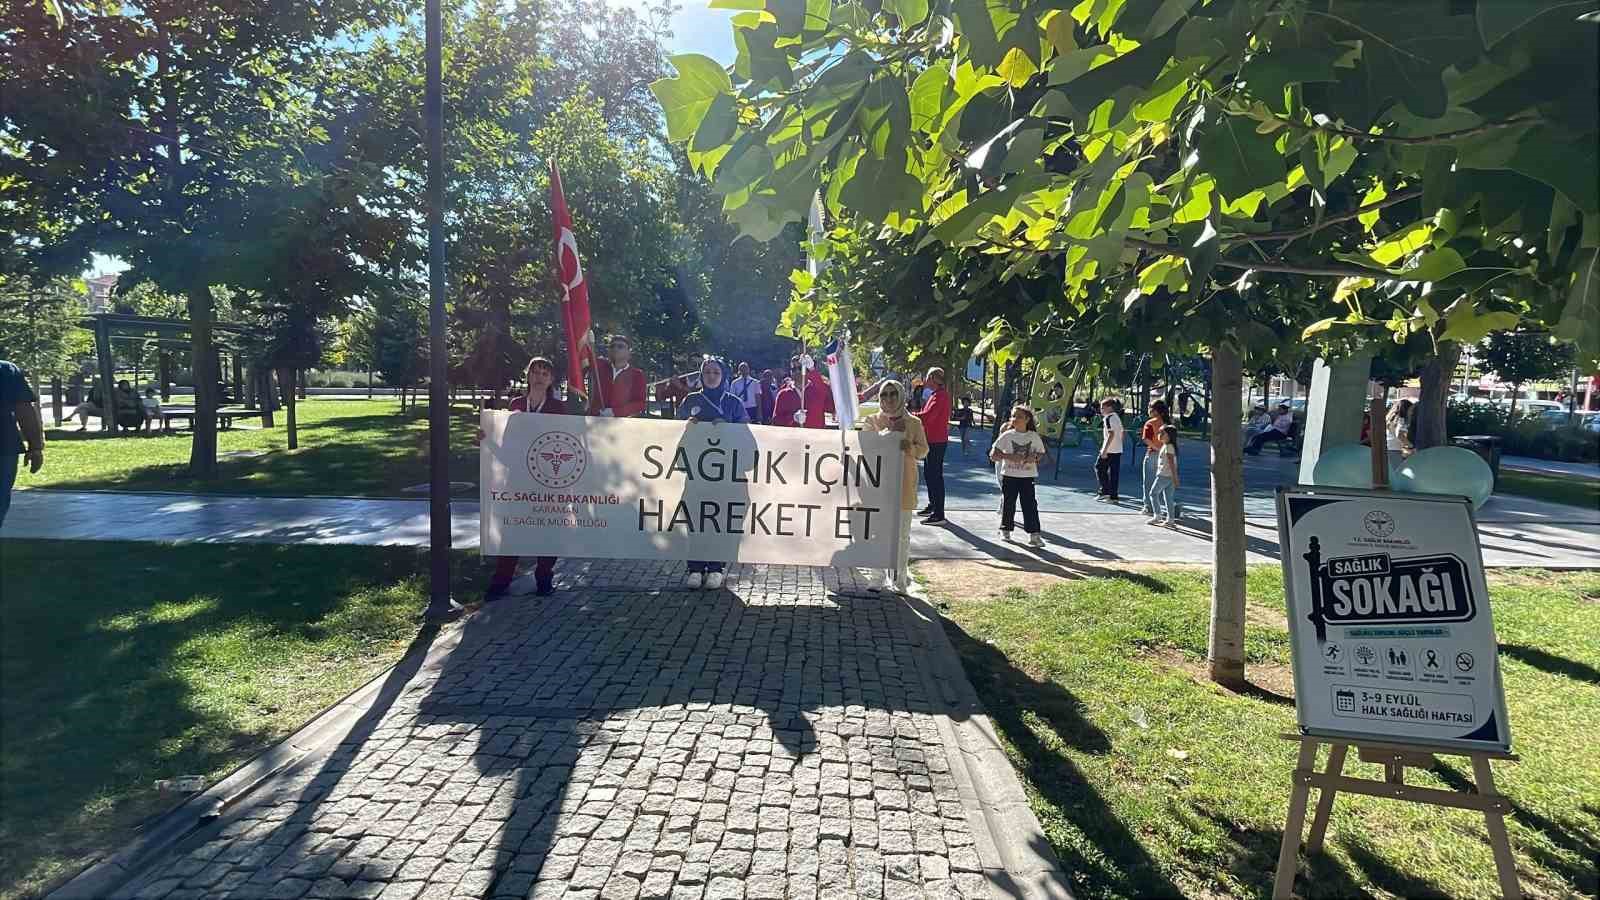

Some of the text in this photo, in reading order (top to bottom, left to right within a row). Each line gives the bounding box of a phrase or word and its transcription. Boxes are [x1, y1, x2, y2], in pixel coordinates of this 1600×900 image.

[641, 438, 882, 494] SAĞLIK İÇİN
[490, 490, 620, 505] T.C. SAĞLIK BAKANLIĞI
[637, 498, 881, 541] HAREKET ET
[1335, 558, 1382, 574] SAĞLIK
[1332, 567, 1457, 616] SOKAĞI
[1385, 693, 1421, 706] EYLÜL
[1361, 705, 1473, 723] HALK SAĞLIĞI HAFTASI
